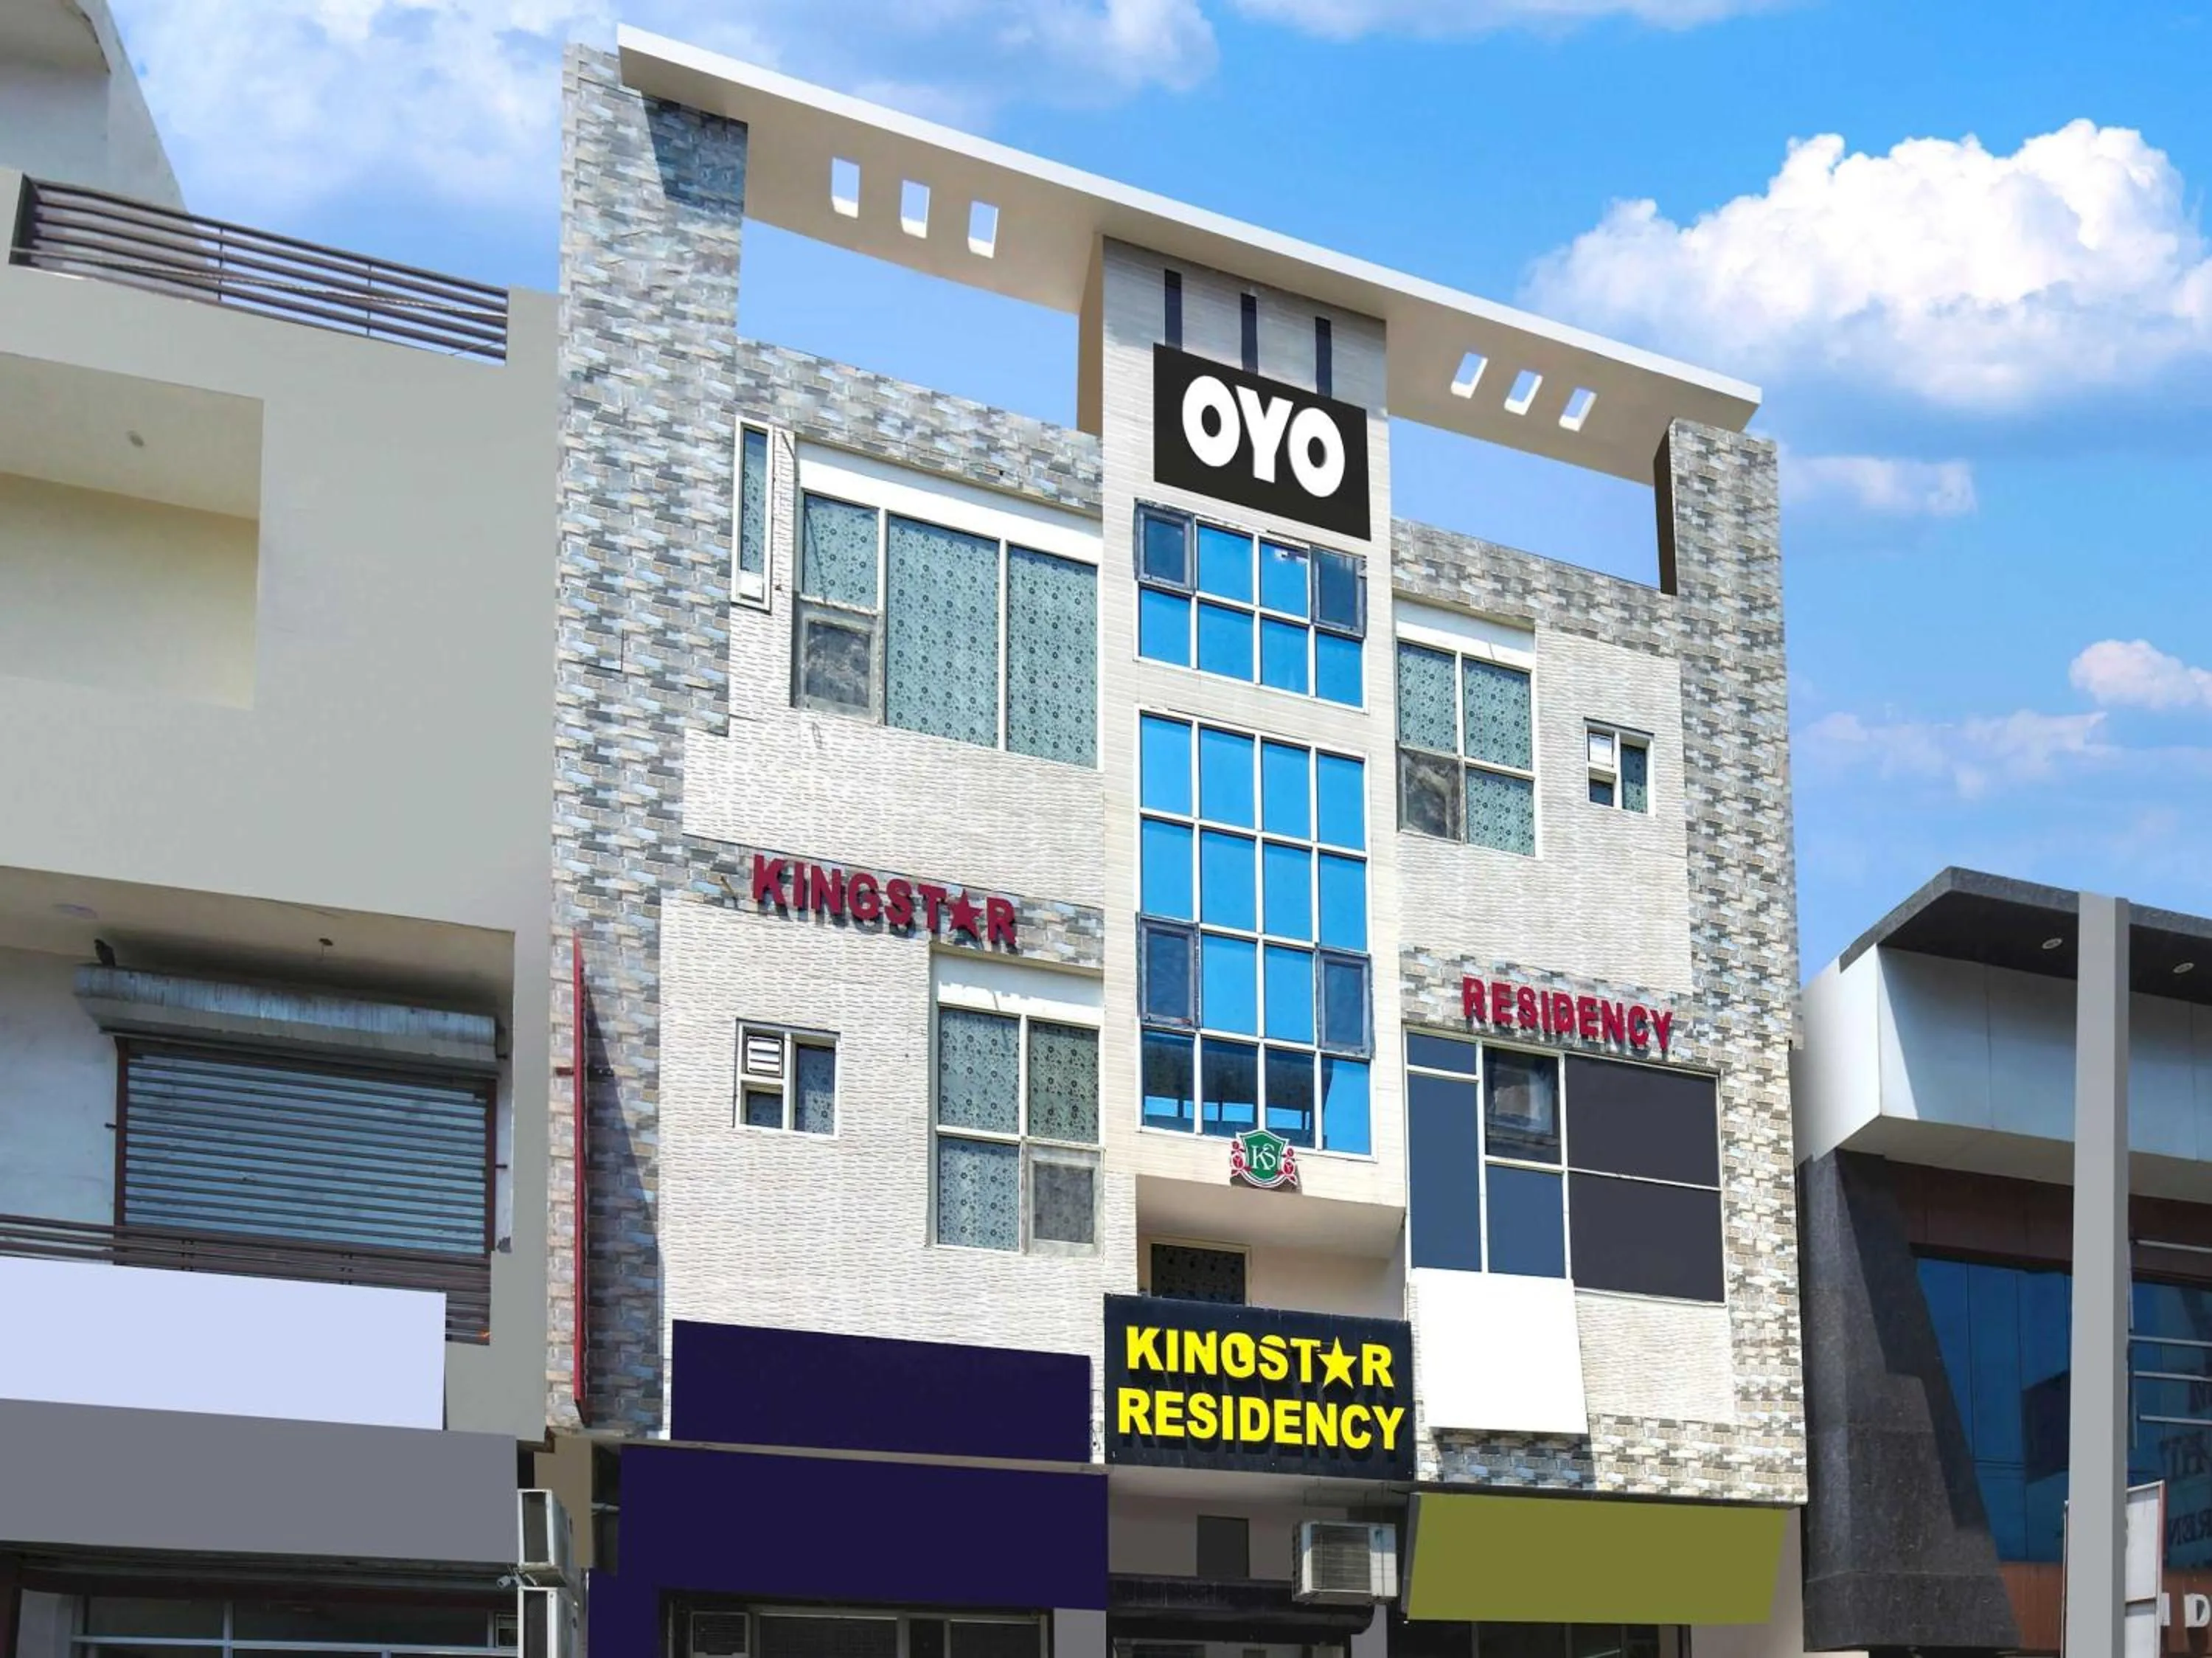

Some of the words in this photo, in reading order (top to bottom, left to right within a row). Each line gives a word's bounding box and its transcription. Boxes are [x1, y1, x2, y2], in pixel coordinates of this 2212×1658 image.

[1182, 375, 1346, 498] OYO
[1462, 976, 1673, 1051] RESIDENCY
[1117, 1387, 1405, 1451] RESIDENCY
